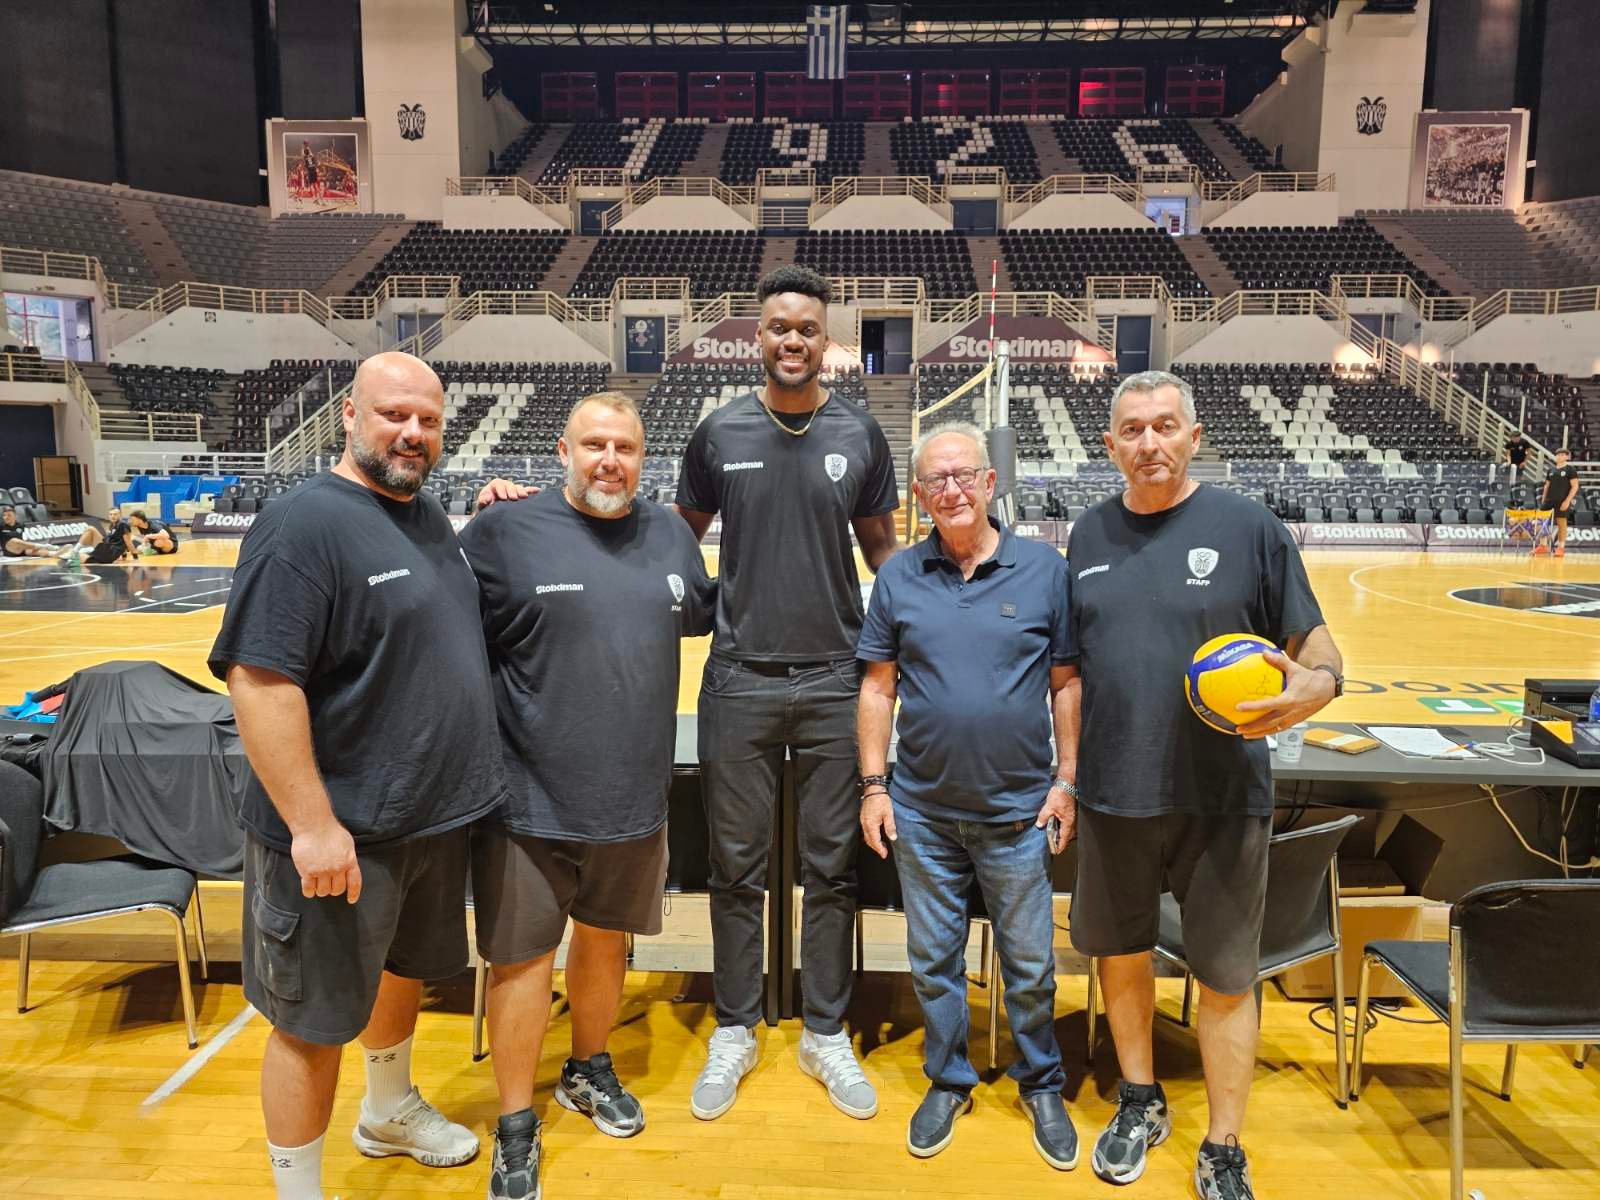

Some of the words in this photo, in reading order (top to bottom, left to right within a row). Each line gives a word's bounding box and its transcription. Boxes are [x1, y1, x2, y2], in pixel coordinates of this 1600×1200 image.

[1311, 525, 1407, 540] Stoiximan
[1186, 578, 1210, 586] STAFF
[369, 1053, 397, 1063] 23
